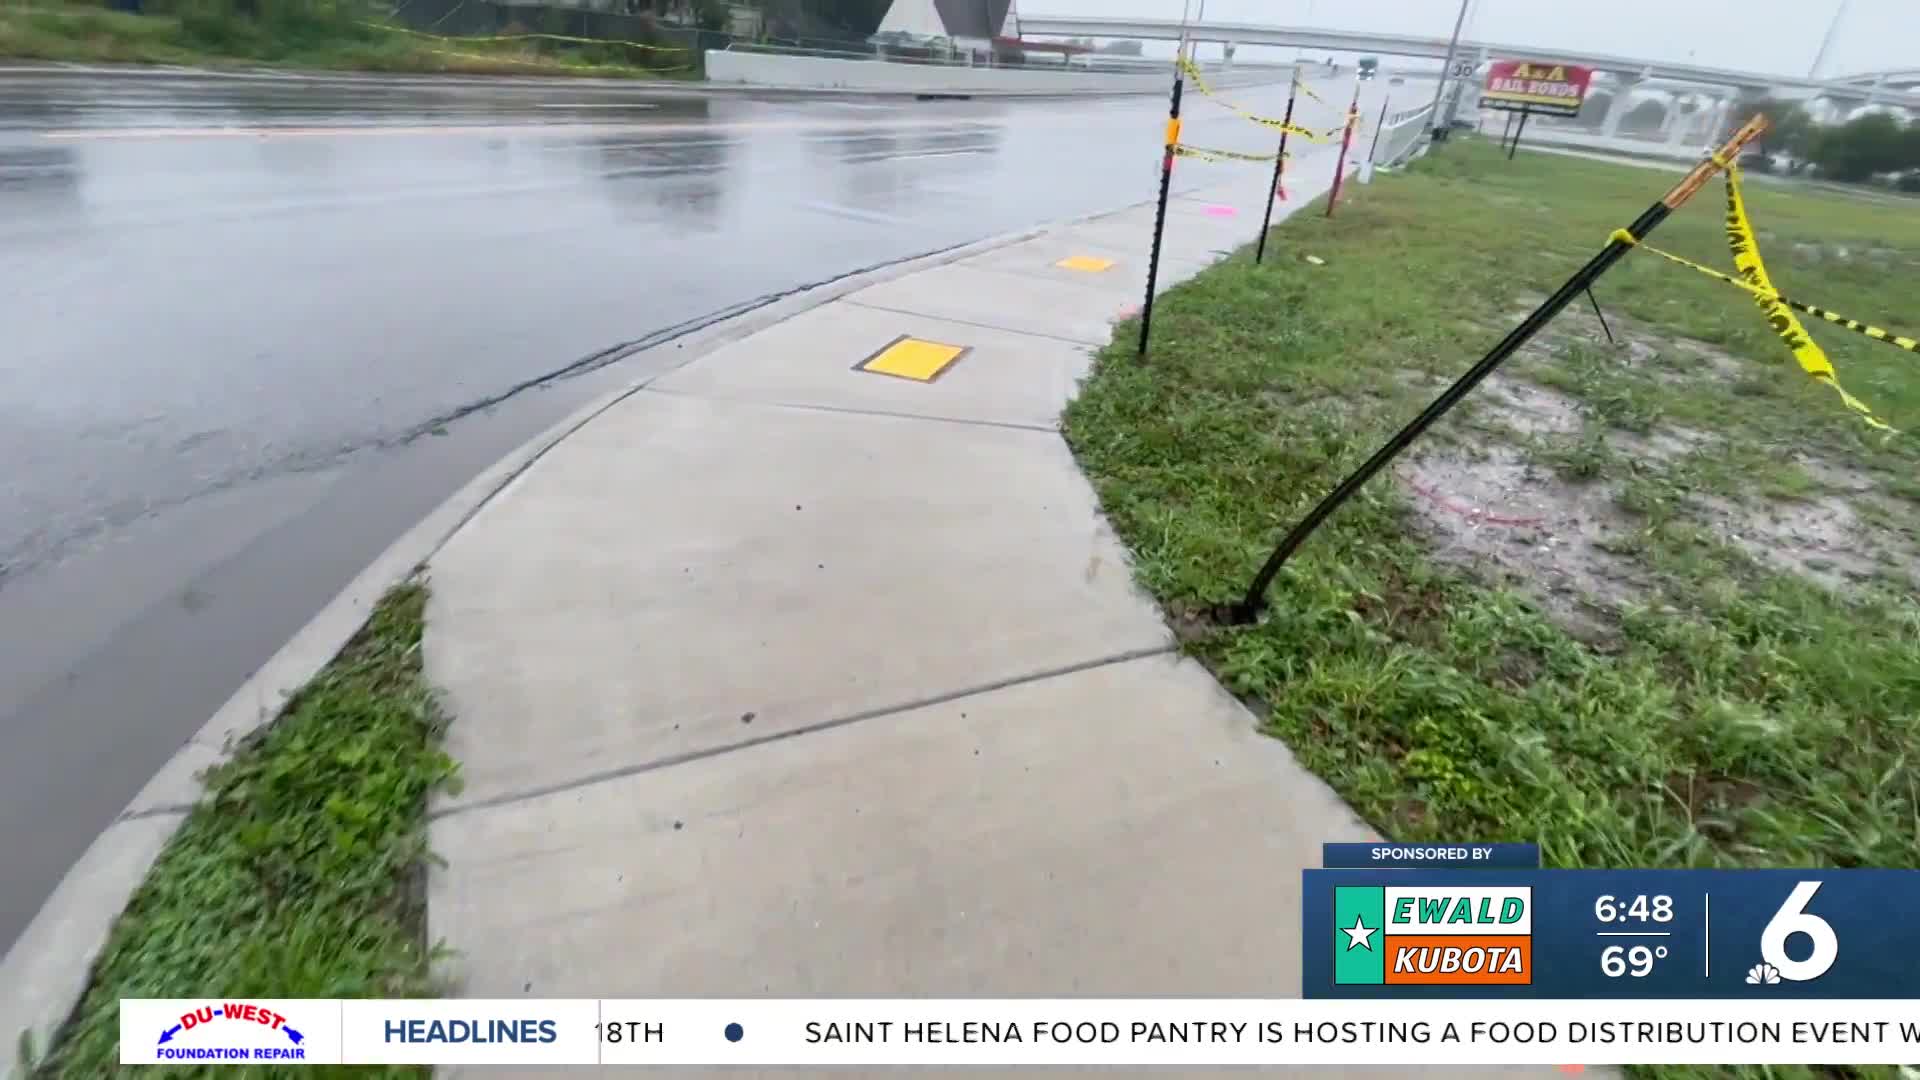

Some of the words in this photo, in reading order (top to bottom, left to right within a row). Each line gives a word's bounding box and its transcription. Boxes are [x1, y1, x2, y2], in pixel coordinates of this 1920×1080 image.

[1453, 63, 1473, 77] 30
[1492, 78, 1525, 93] BAIL
[1527, 81, 1581, 97] BONDS
